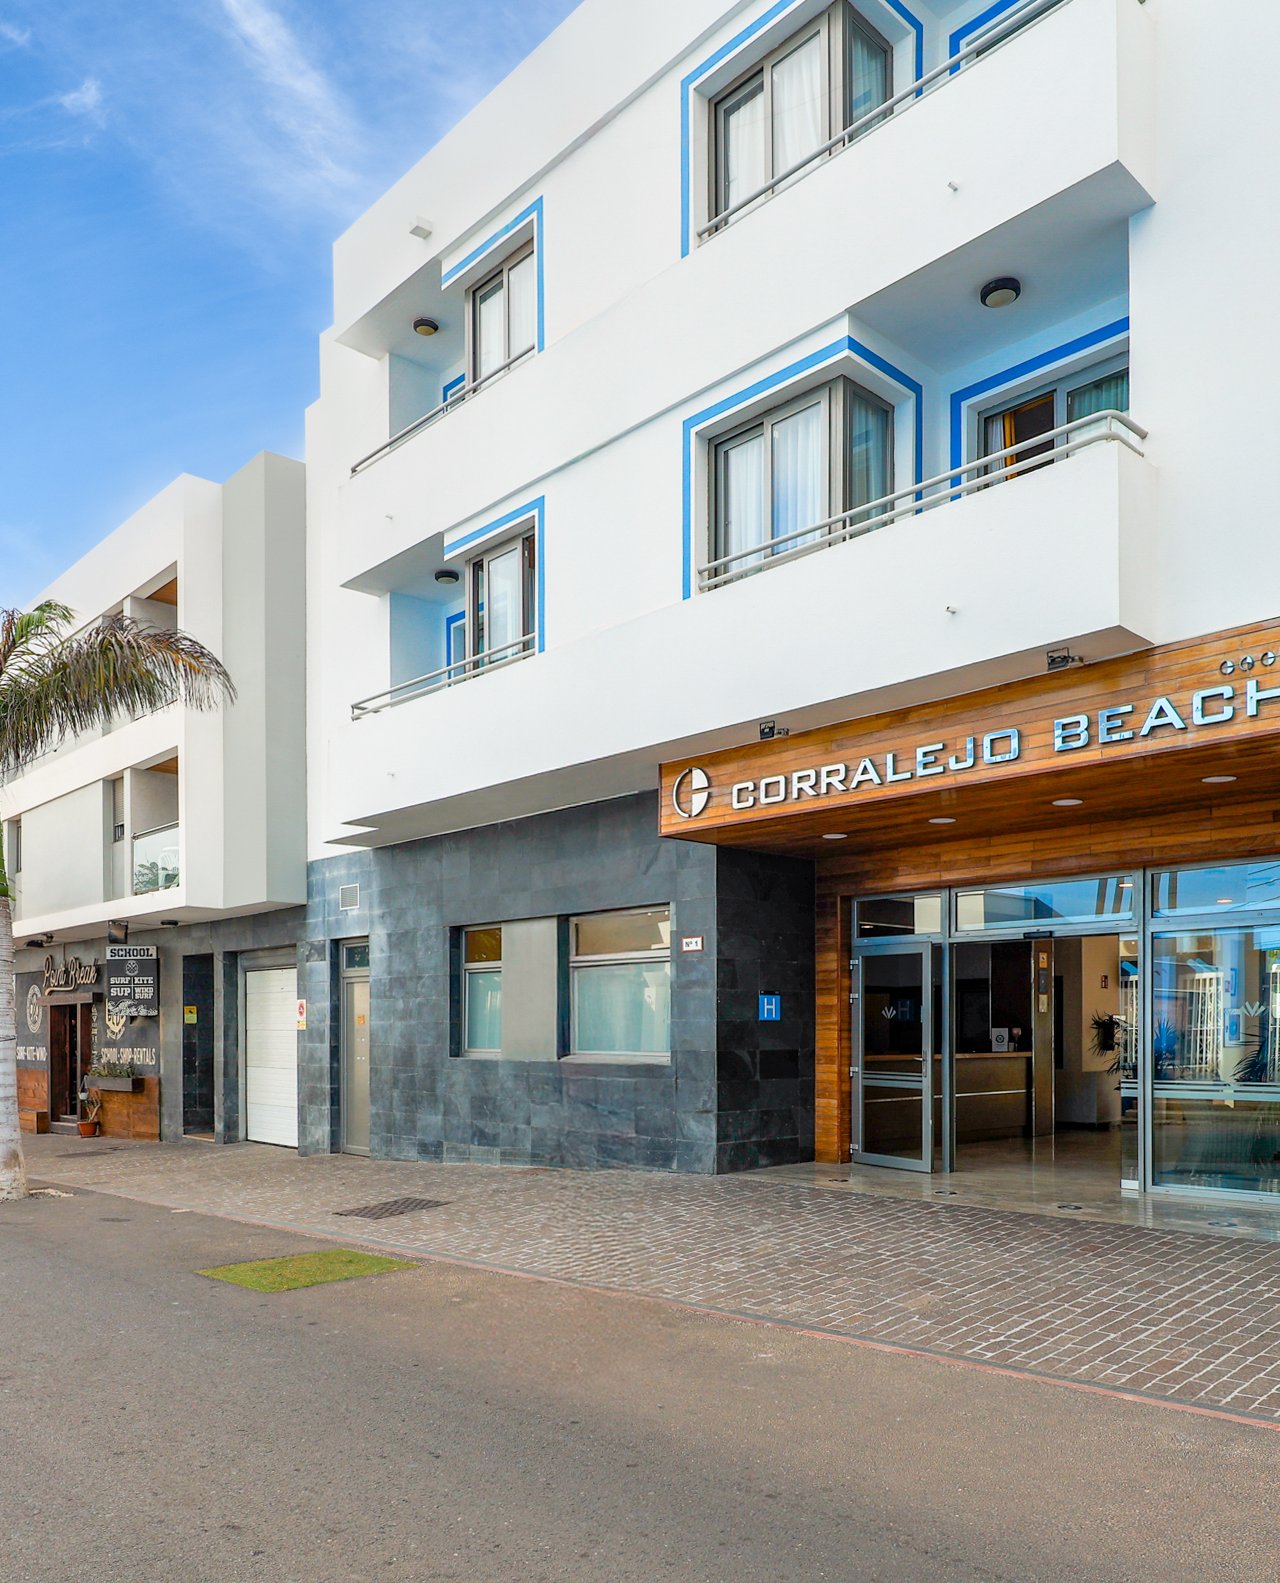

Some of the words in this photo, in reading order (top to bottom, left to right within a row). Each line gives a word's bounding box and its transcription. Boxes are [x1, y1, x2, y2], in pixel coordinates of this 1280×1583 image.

[731, 727, 1020, 811] CORRALEJO
[110, 948, 153, 958] SCHOOL
[110, 976, 131, 984] SURF
[134, 976, 153, 984] KITE
[110, 987, 131, 996] SUP
[764, 997, 776, 1018] H
